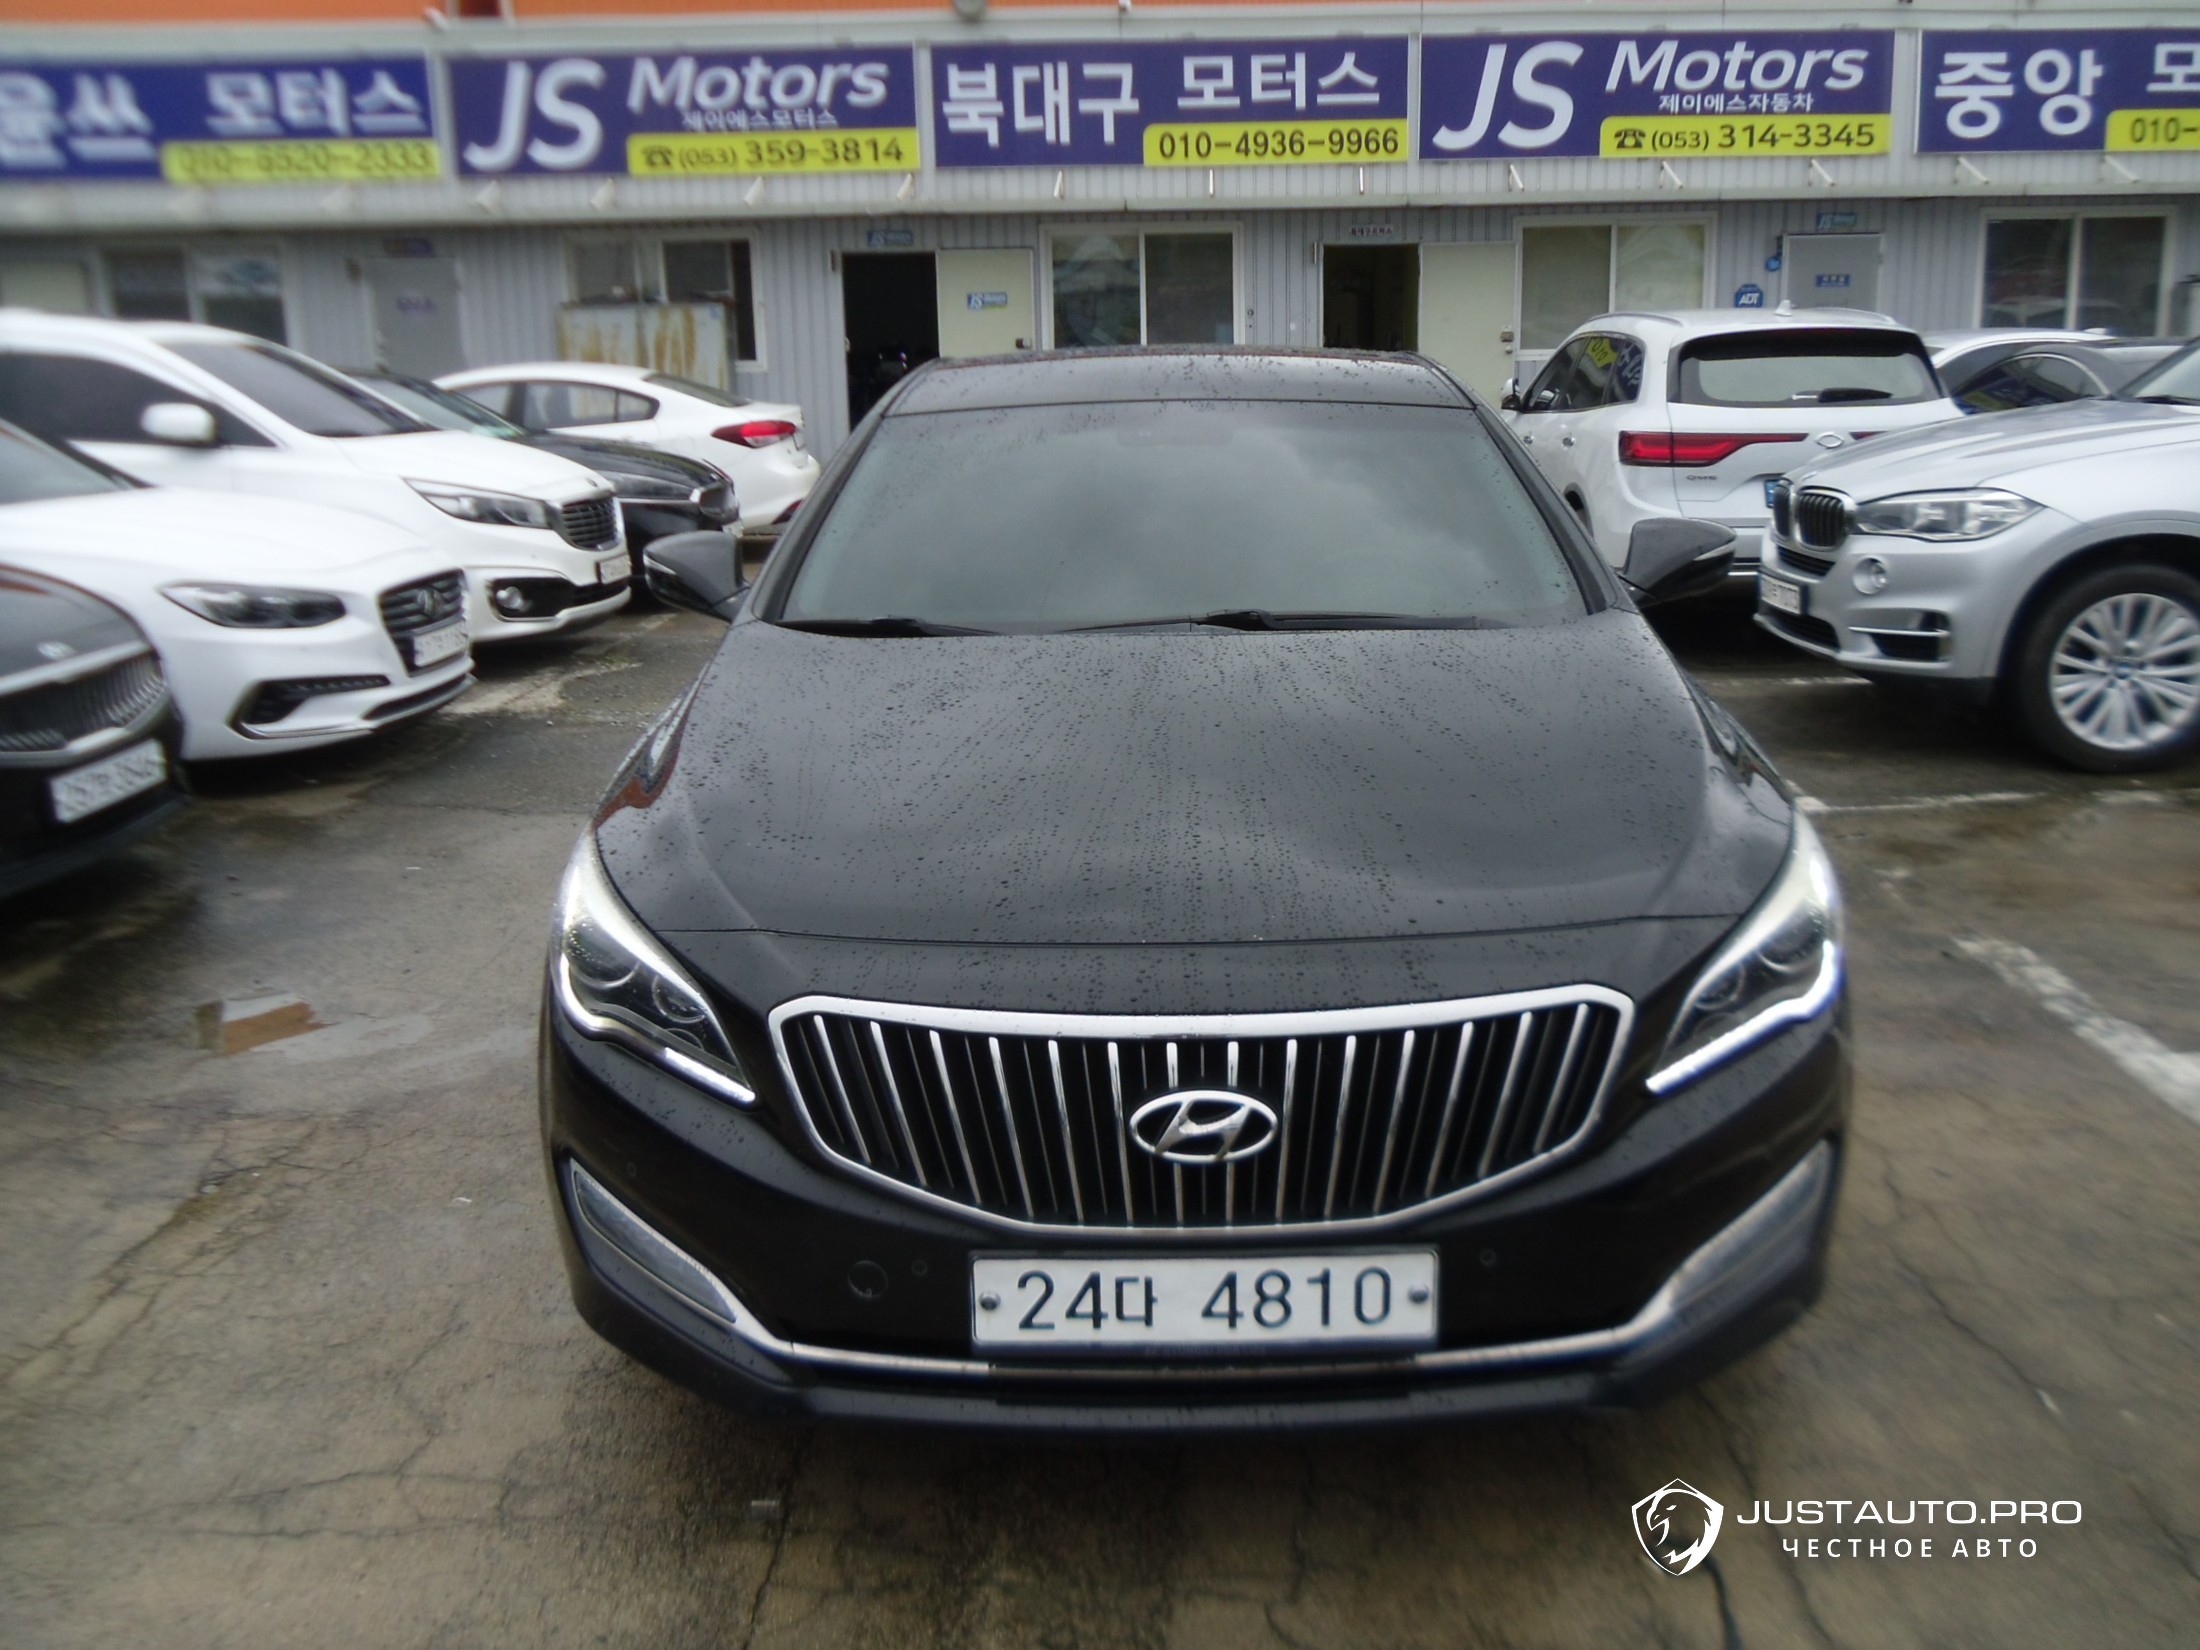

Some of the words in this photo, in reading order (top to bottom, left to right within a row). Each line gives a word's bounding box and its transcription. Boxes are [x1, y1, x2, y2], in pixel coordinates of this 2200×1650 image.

[627, 56, 889, 114] Motors
[1605, 40, 1868, 93] Motors
[1935, 49, 2104, 138] 중앙
[205, 68, 428, 137] 모터스
[461, 58, 606, 172] JS
[682, 108, 839, 131] 제이에스모터스
[943, 61, 1140, 148] 북대구
[1177, 52, 1379, 110] 모터스
[1432, 41, 1584, 150] JS
[1659, 94, 1813, 114] 제이에스자동차
[679, 146, 737, 170] (053)
[744, 137, 904, 165] 359-3814
[1159, 128, 1400, 159] 010-4936-9966
[1651, 129, 1710, 152] (053)
[1717, 123, 1876, 149] 314-3345
[1739, 293, 1760, 304] ADT
[1017, 1270, 1158, 1330] 24다
[1201, 1267, 1392, 1329] 4810
